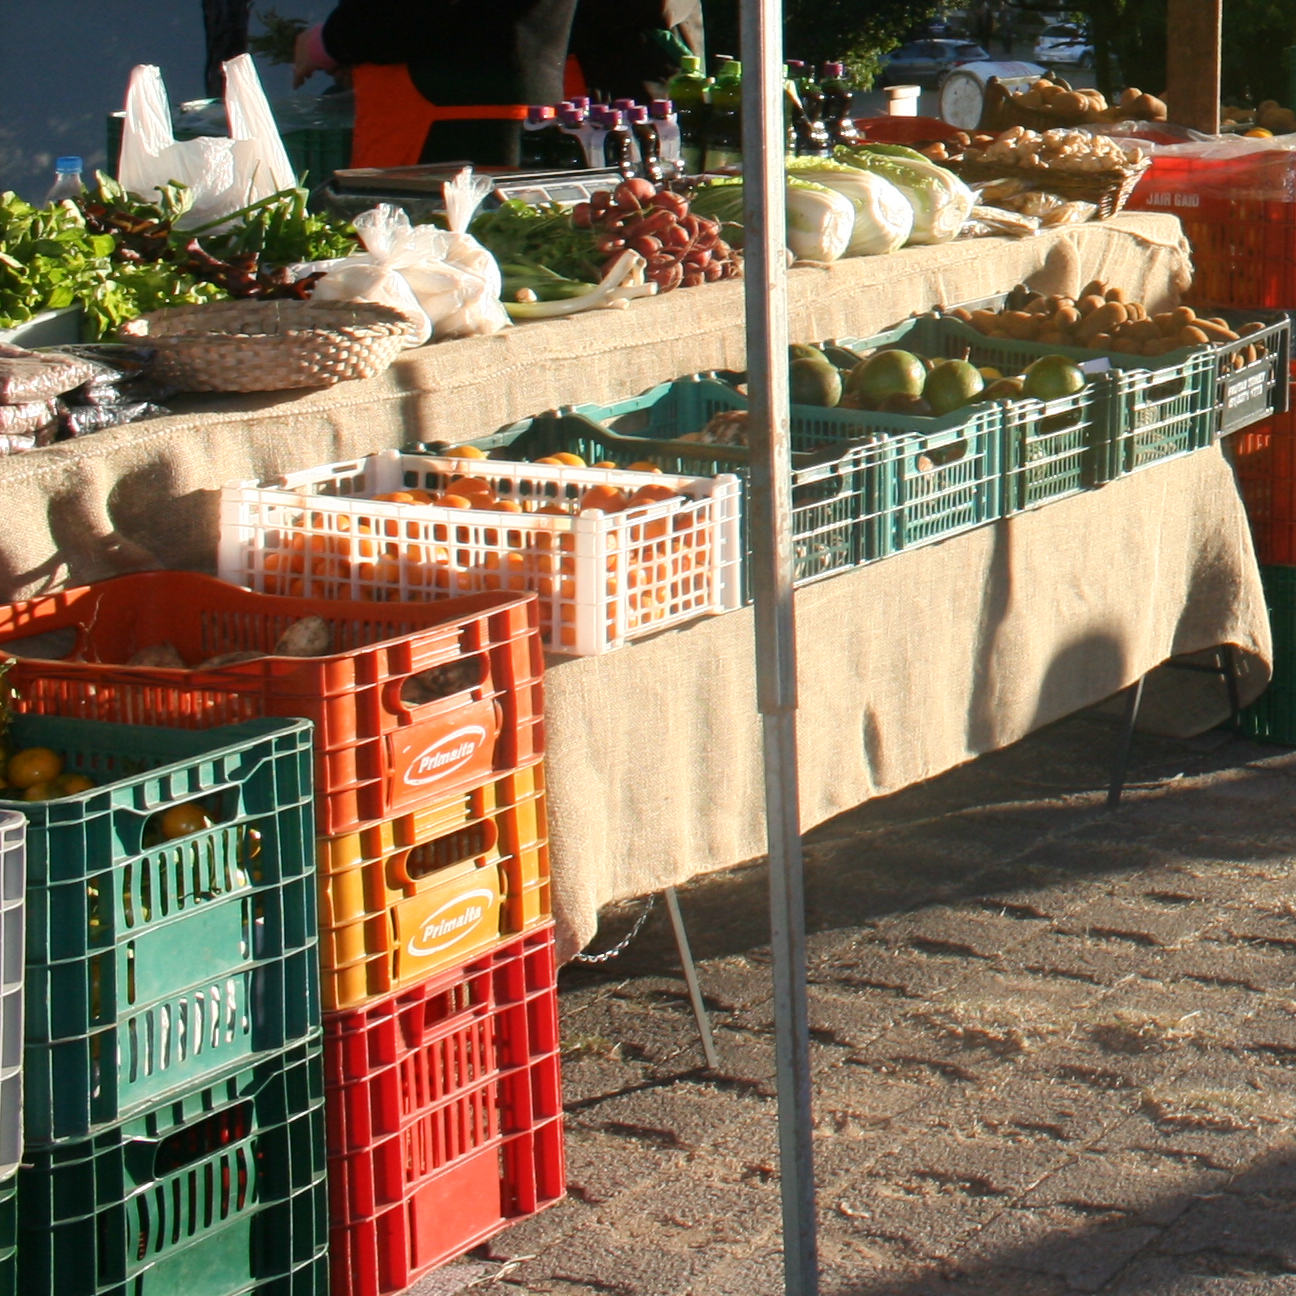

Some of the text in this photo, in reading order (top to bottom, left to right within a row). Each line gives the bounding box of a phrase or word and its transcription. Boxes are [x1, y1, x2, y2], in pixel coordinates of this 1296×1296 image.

[1146, 193, 1171, 206] JAIR
[418, 742, 475, 774] Primalta
[422, 906, 482, 943] Primalta
